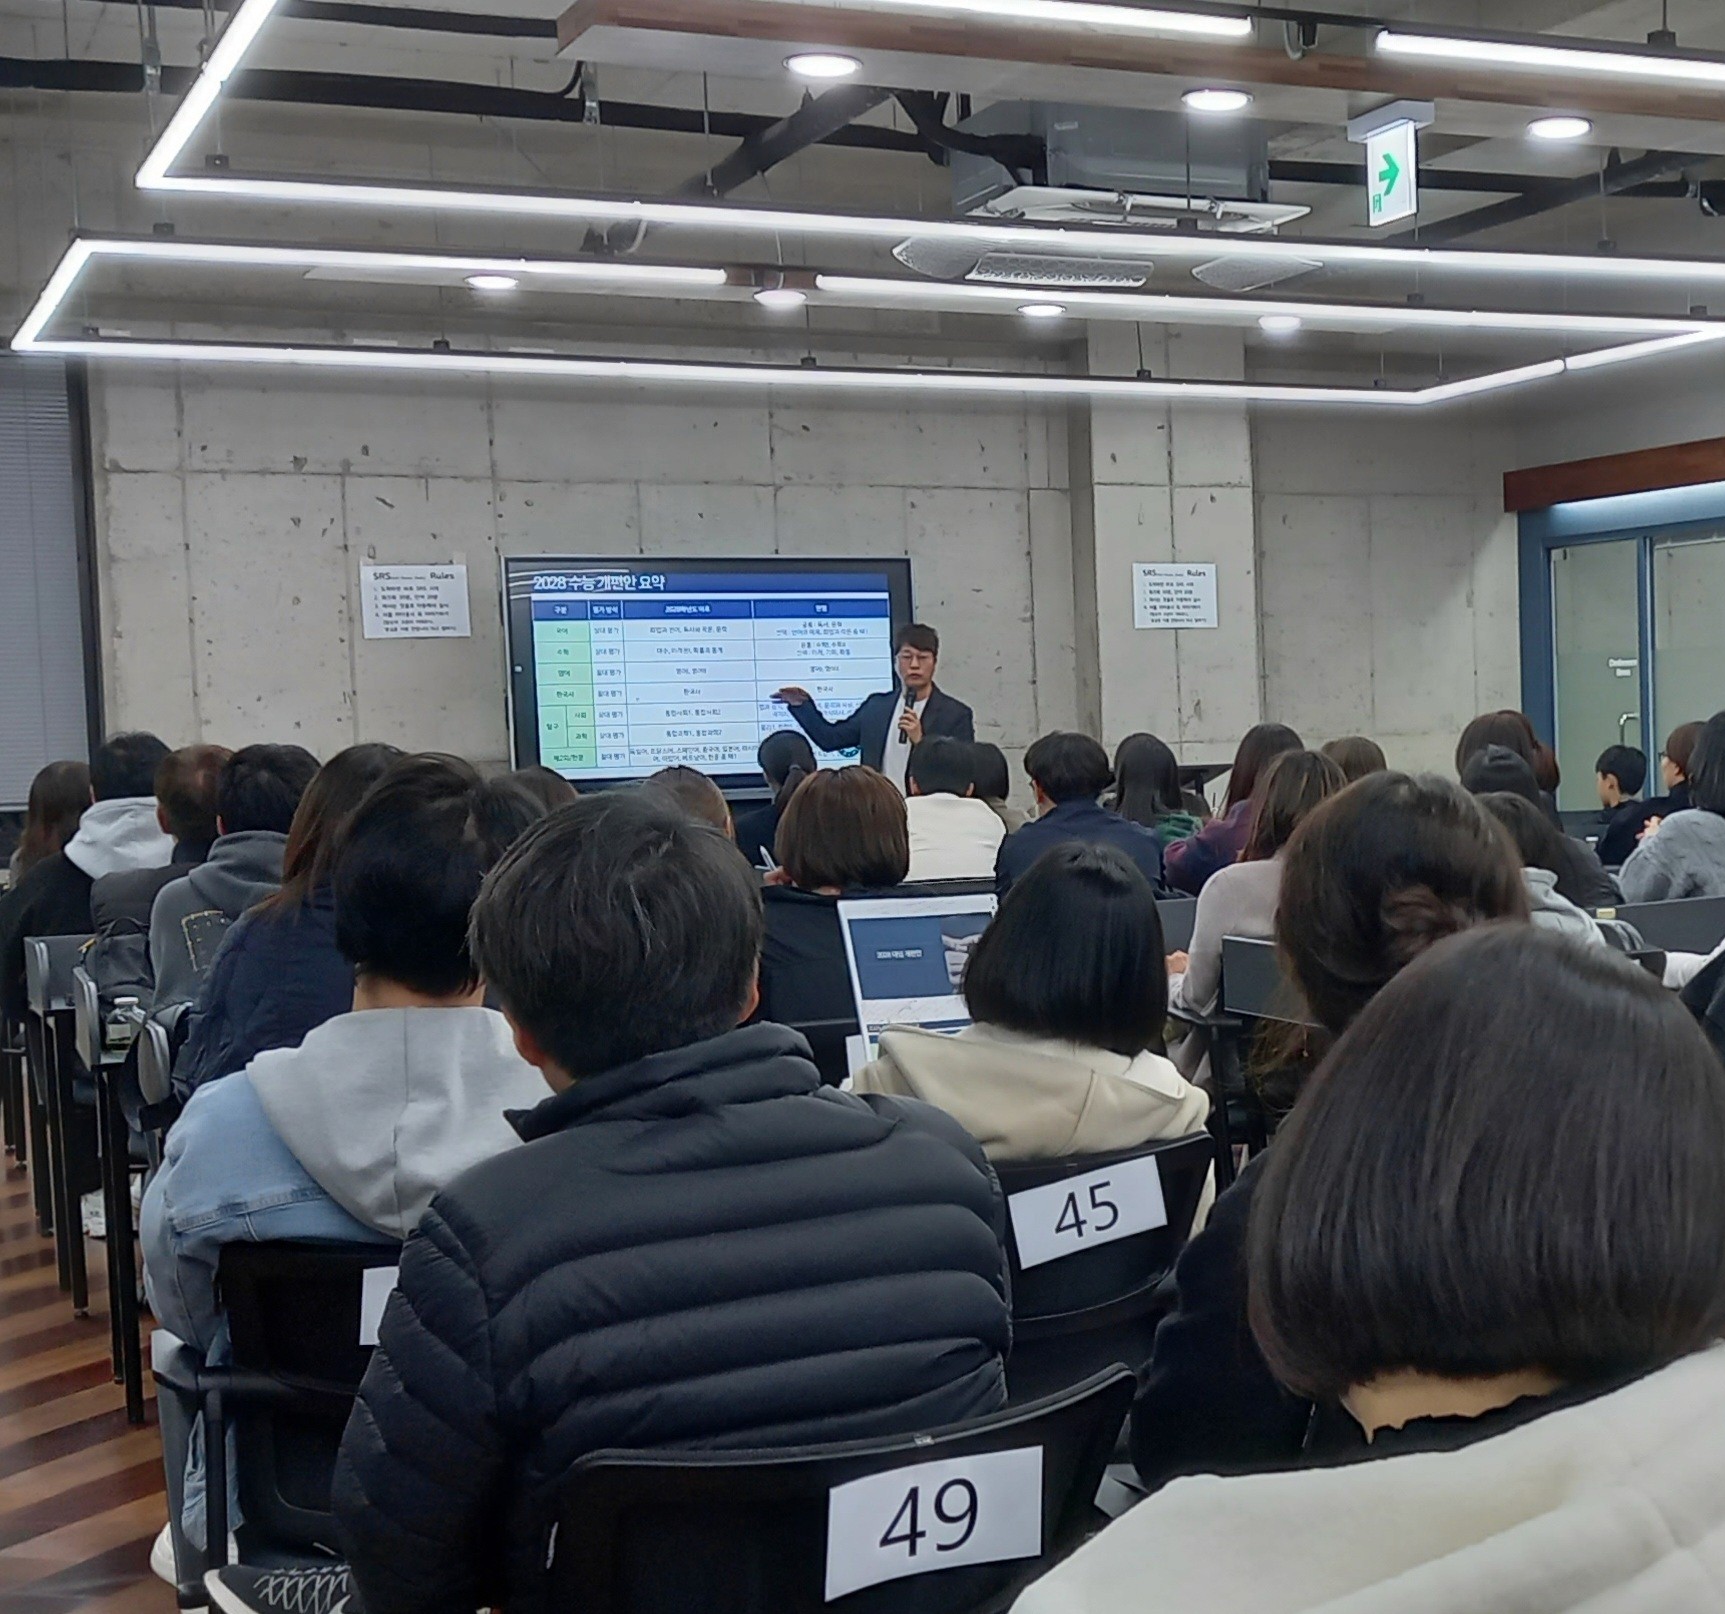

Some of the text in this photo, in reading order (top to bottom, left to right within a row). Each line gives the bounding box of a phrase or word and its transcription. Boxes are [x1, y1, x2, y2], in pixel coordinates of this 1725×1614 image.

[534, 575, 665, 590] 2028 수능 개편안 요약
[1054, 1180, 1119, 1238] 45
[879, 1478, 978, 1557] 49
